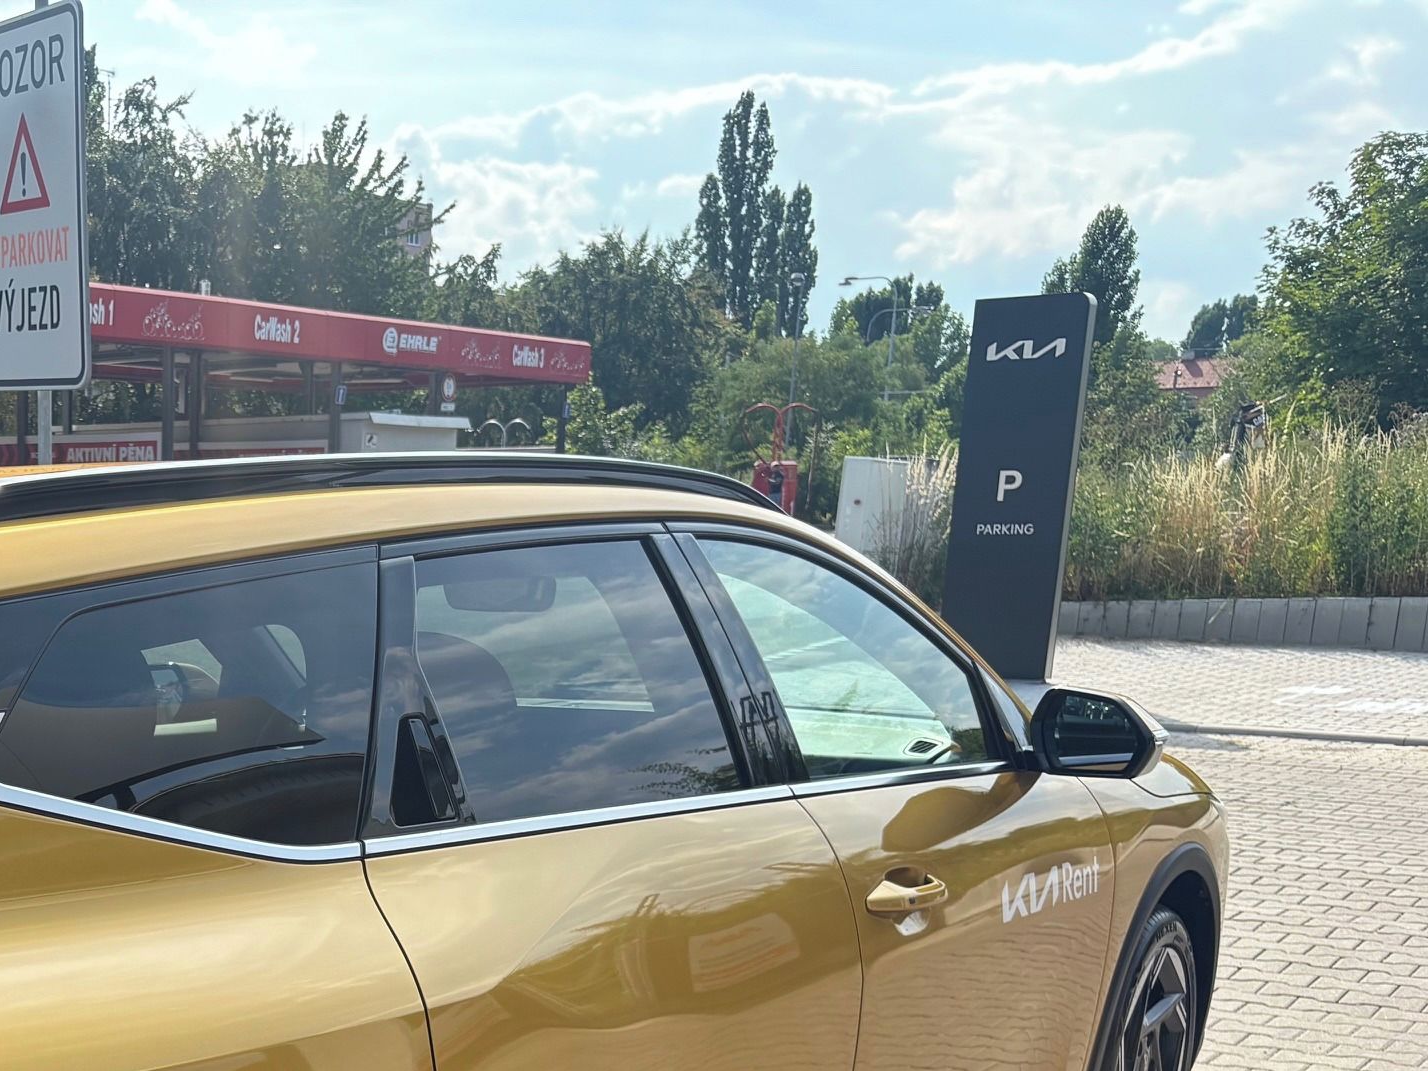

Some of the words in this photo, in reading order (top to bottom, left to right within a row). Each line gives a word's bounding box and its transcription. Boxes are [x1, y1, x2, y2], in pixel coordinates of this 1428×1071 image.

[254, 314, 291, 344] CarWash
[293, 319, 300, 344] 2
[399, 333, 439, 353] EHRLE
[512, 343, 539, 368] CarWash
[986, 337, 1067, 362] KIA
[67, 443, 116, 463] AKTIVNÍ
[119, 443, 153, 462] PĚNA
[996, 469, 1023, 502] P
[976, 523, 1035, 536] PARKING
[1001, 865, 1059, 924] KIA
[1062, 855, 1100, 903] Rent
